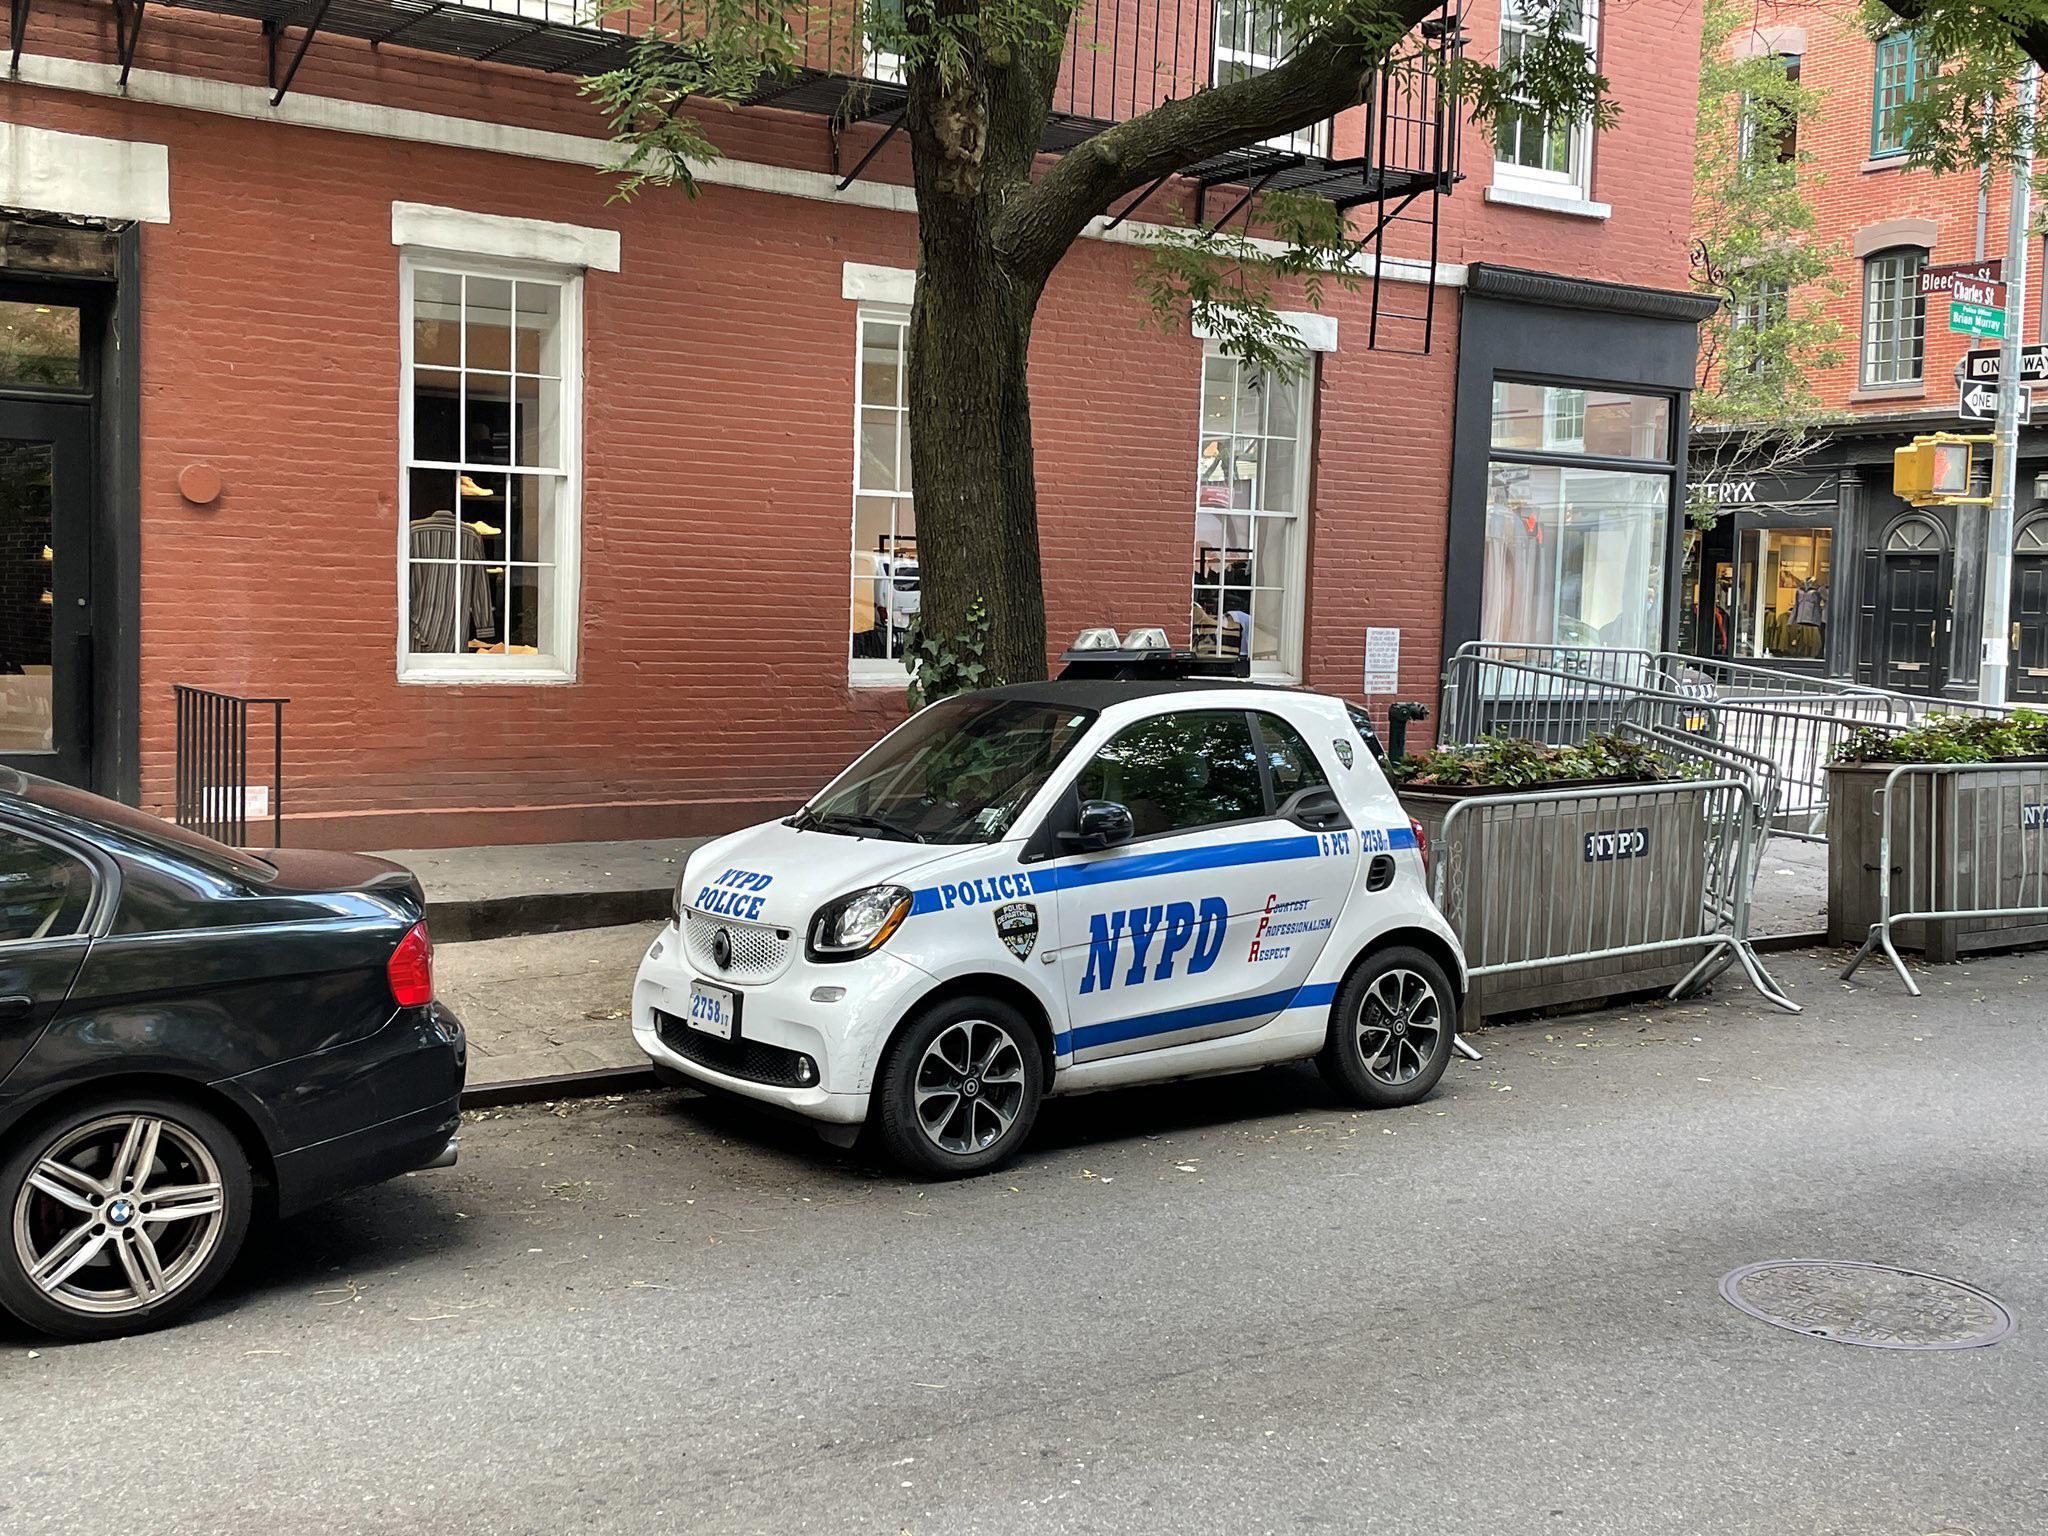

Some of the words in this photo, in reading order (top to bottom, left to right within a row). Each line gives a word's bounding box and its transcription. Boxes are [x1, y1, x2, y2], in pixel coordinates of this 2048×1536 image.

[1922, 273, 1953, 291] Bleec
[1953, 281, 1983, 303] Charles
[1984, 286, 1995, 306] St
[1952, 311, 1973, 325] Brian
[1974, 315, 2001, 332] Murray
[1981, 360, 2000, 373] ON
[1972, 394, 1991, 408] ONE
[2023, 806, 2048, 824] NY
[1321, 834, 1330, 857] 6
[1330, 832, 1350, 856] PCT
[1361, 829, 1384, 853] 2758
[1589, 831, 1645, 857] NYPD
[713, 868, 773, 891] NYPD
[941, 872, 1031, 909] POLICE
[694, 886, 766, 920] POLICE
[1002, 903, 1028, 914] POLICE
[1255, 917, 1333, 938] PROFESSIONALISM
[1079, 896, 1228, 995] NYPD
[1247, 940, 1291, 963] RESPECT
[691, 994, 721, 1024] 2758
